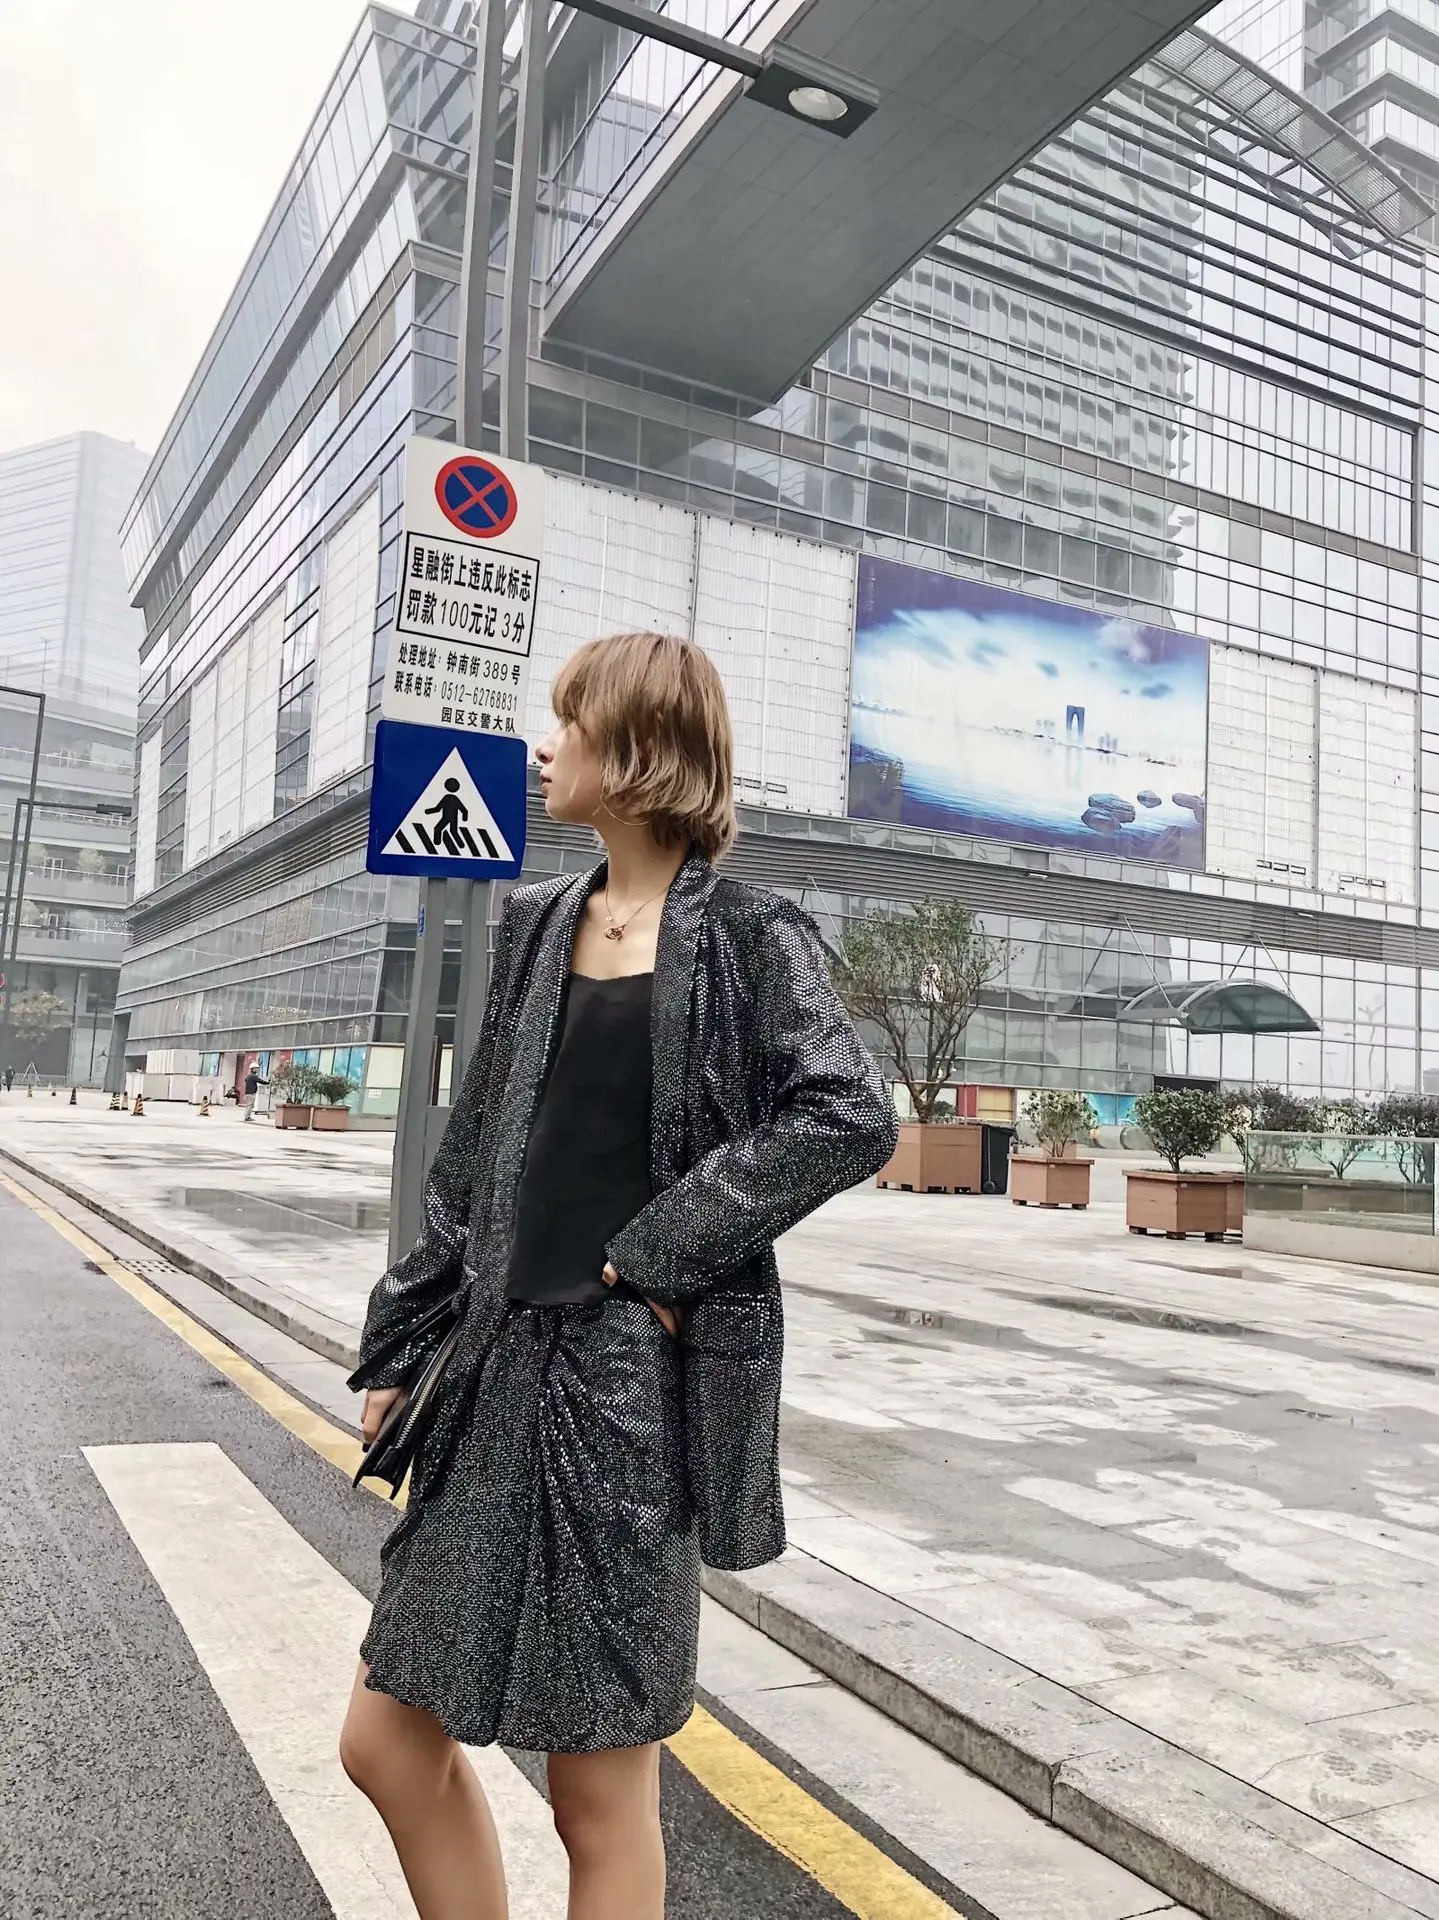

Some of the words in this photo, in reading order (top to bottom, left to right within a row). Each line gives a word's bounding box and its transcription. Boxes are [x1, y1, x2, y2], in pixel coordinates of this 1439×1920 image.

[411, 546, 532, 602] 星融街上违反此标志
[441, 706, 516, 733] 园区交警大队
